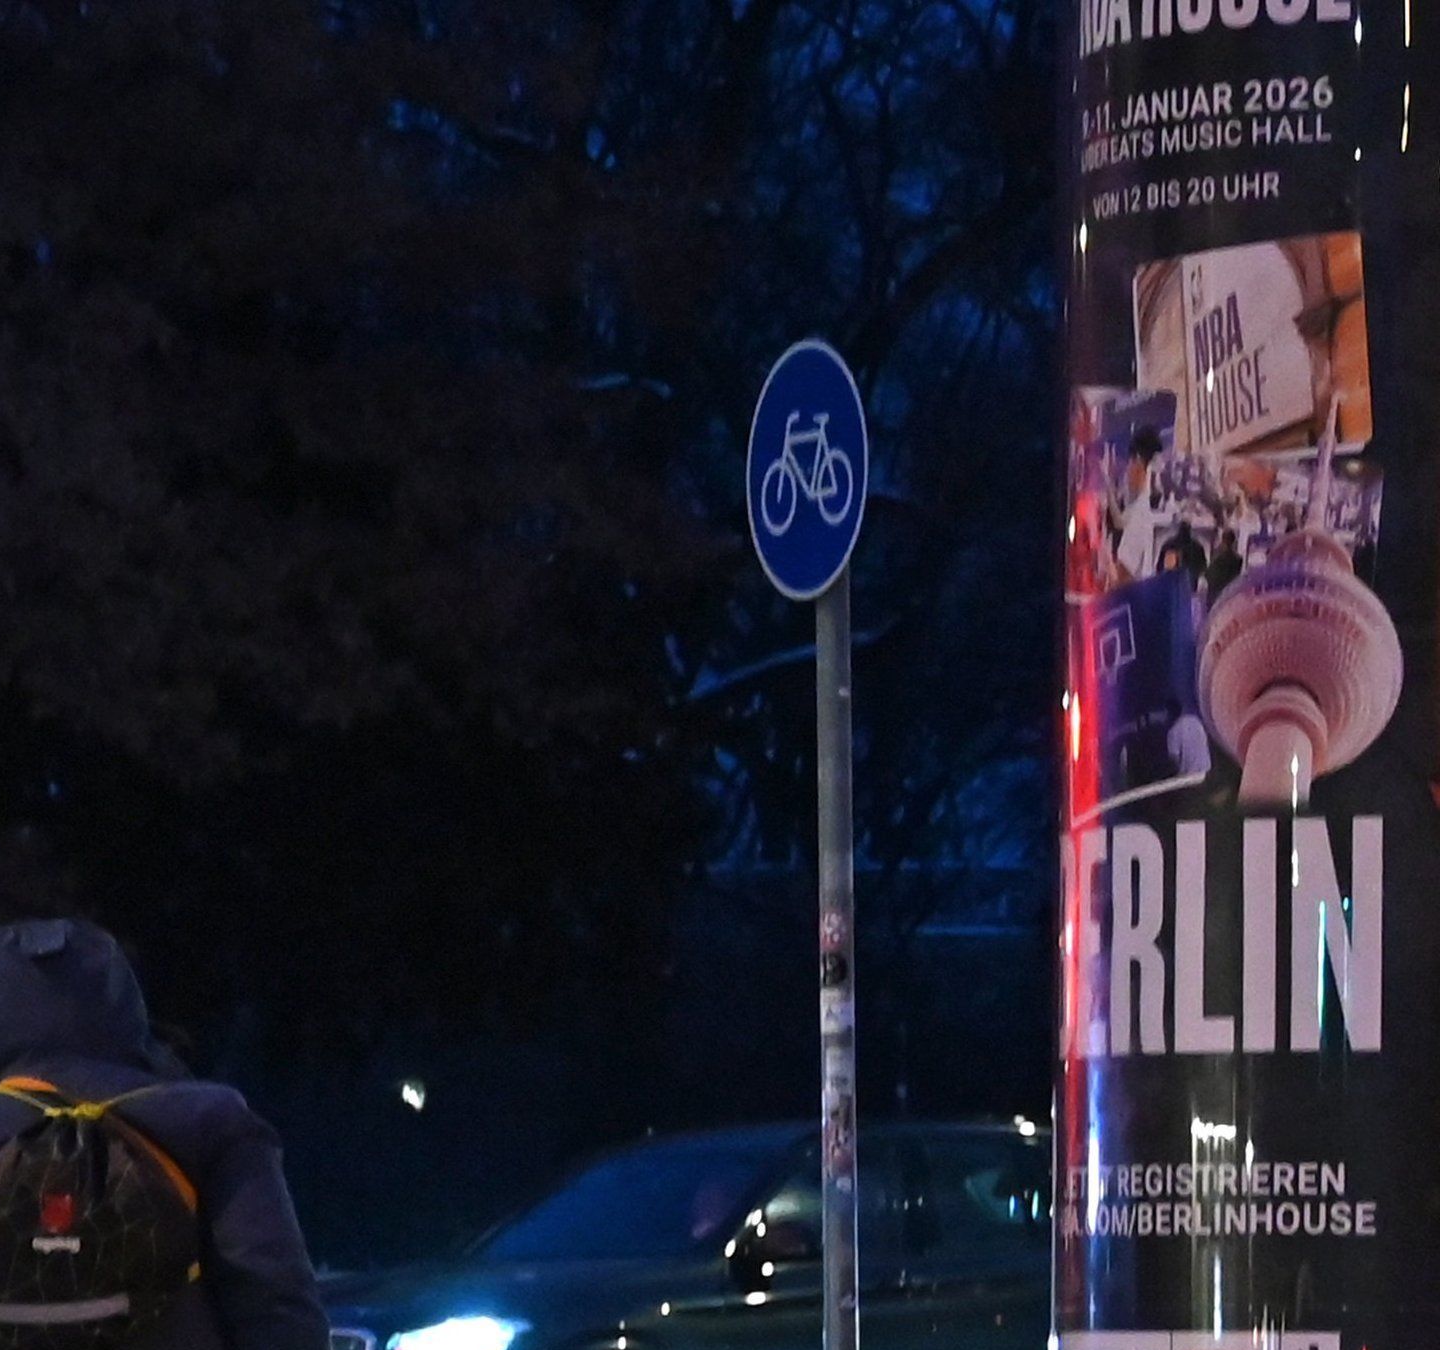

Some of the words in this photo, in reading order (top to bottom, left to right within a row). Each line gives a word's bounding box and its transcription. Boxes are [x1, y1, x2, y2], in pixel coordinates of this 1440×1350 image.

[1121, 81, 1232, 129] JANUAR
[1243, 75, 1334, 113] 2026
[1161, 119, 1242, 156] MUSIC
[1252, 113, 1332, 147] HALL
[1093, 190, 1119, 221] VON
[1123, 184, 1141, 215] 12
[1146, 178, 1180, 210] BIS
[1187, 175, 1216, 206] 20
[1223, 170, 1280, 201] UHR
[1193, 291, 1244, 382] NBA
[1196, 345, 1270, 448] HOUSE
[1119, 1161, 1346, 1198] REGISTRIEREN
